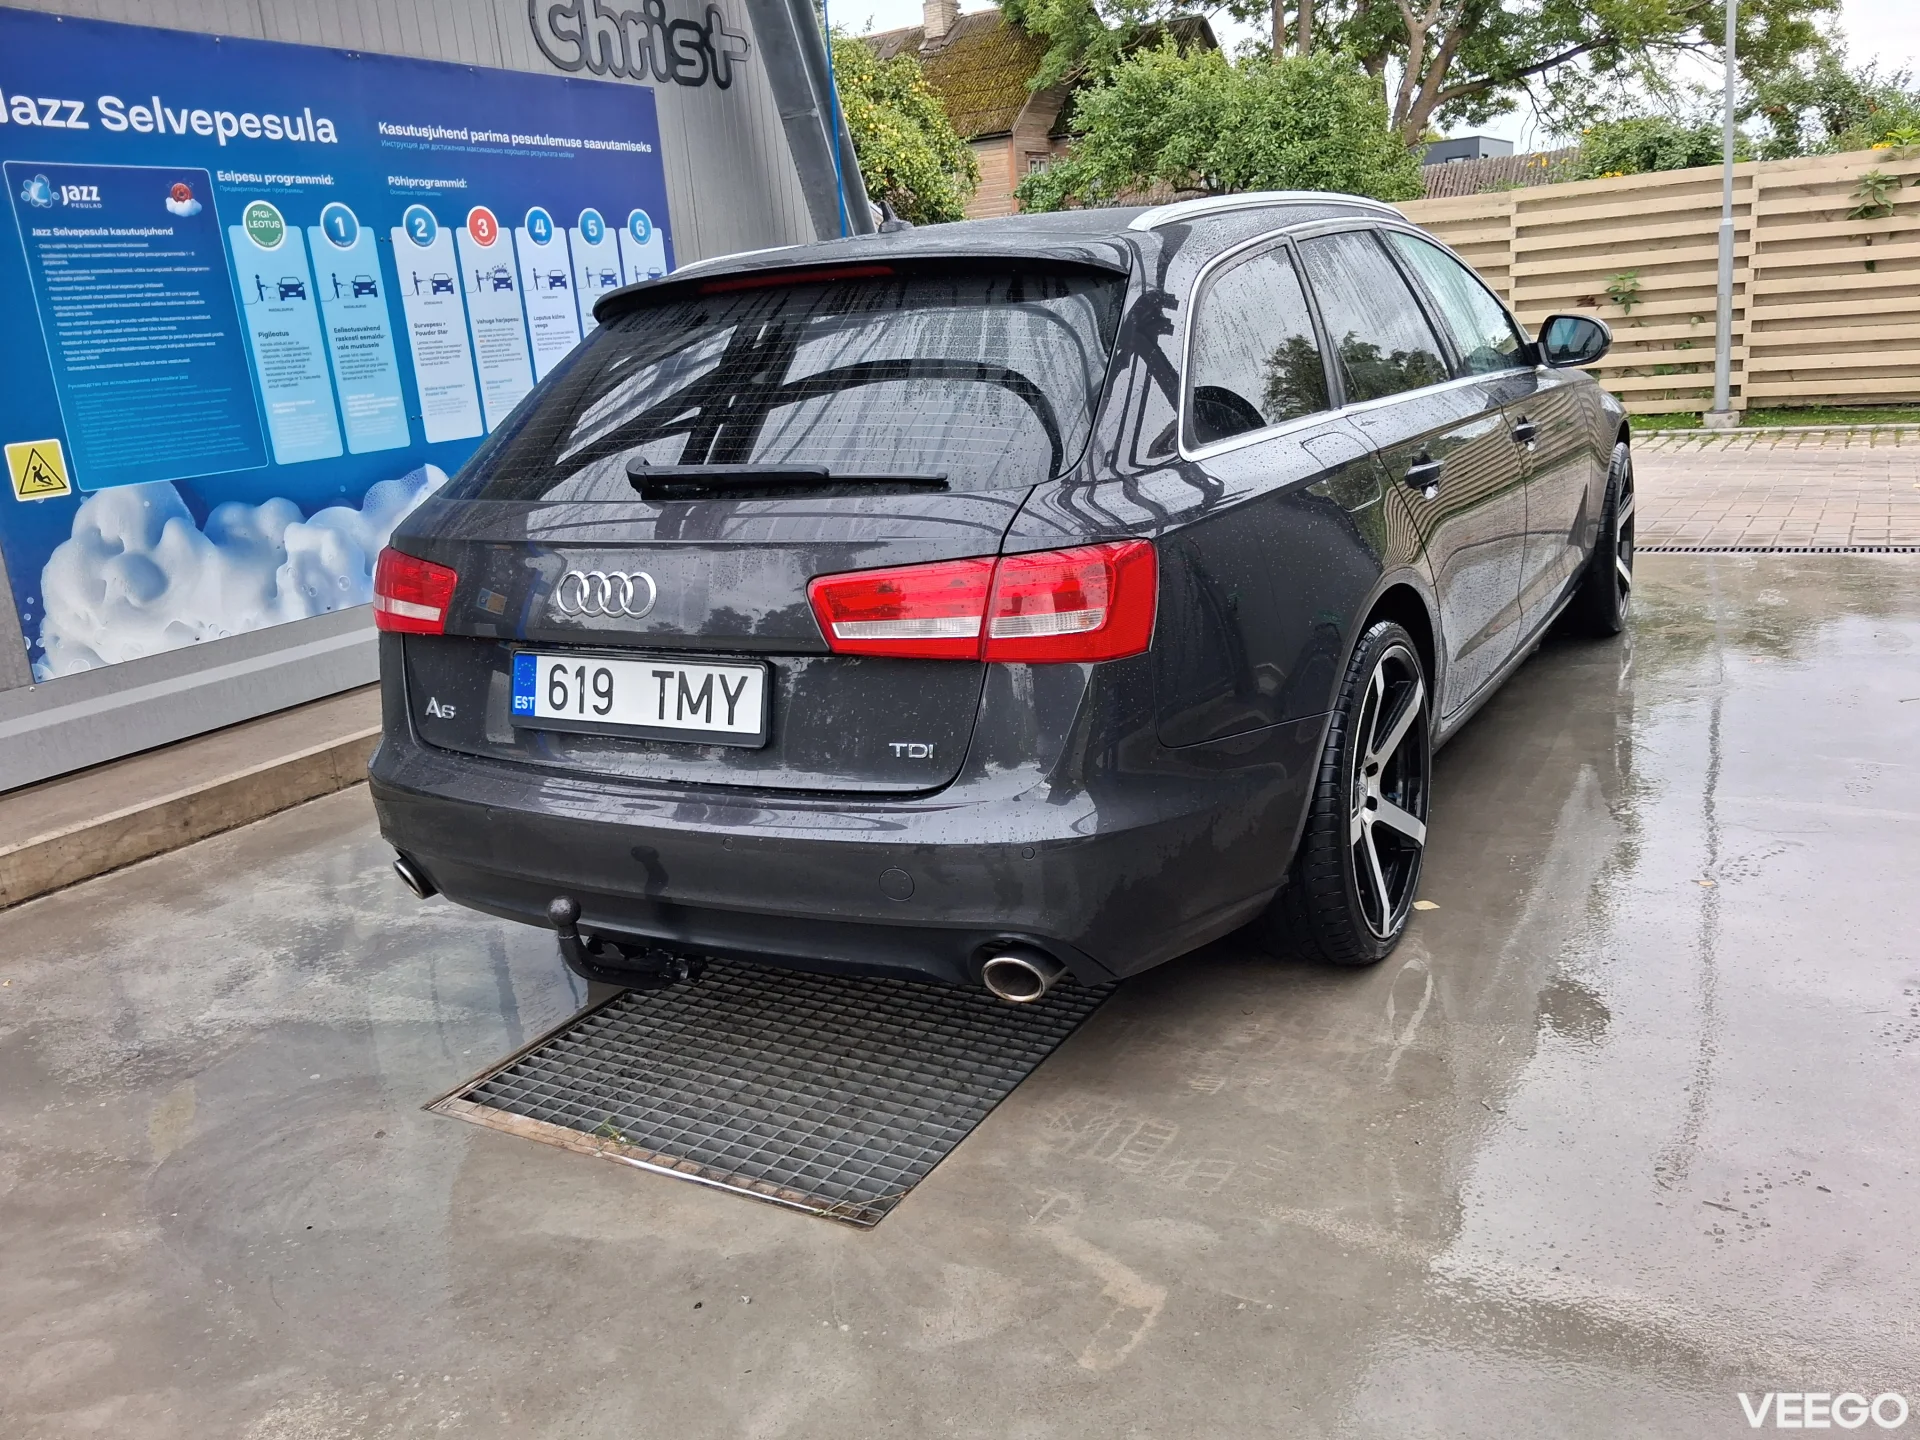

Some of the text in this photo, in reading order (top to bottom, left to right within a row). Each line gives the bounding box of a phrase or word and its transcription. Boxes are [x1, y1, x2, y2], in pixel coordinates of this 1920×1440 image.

[97, 95, 338, 146] Selvepesula
[378, 121, 652, 153] Kasutusjuhend parima pesutulemuse saavutamiseks
[217, 170, 335, 186] Eelpesu programmid:
[388, 174, 468, 190] Põhiprogrammid:
[252, 210, 272, 219] PIGI-
[32, 227, 174, 238] Jazz Selvepesula kasutusjuhend
[248, 220, 281, 229] LEOTUS
[335, 216, 345, 237] 1
[414, 217, 428, 237] 2
[477, 218, 489, 237] 3
[535, 218, 547, 237] 4
[588, 219, 598, 237] 5
[635, 219, 646, 237] 6
[257, 330, 290, 338] Pigileotus
[514, 695, 535, 710] EST
[547, 663, 748, 726] 619 TMY
[425, 696, 457, 720] A6
[888, 741, 934, 759] TDI
